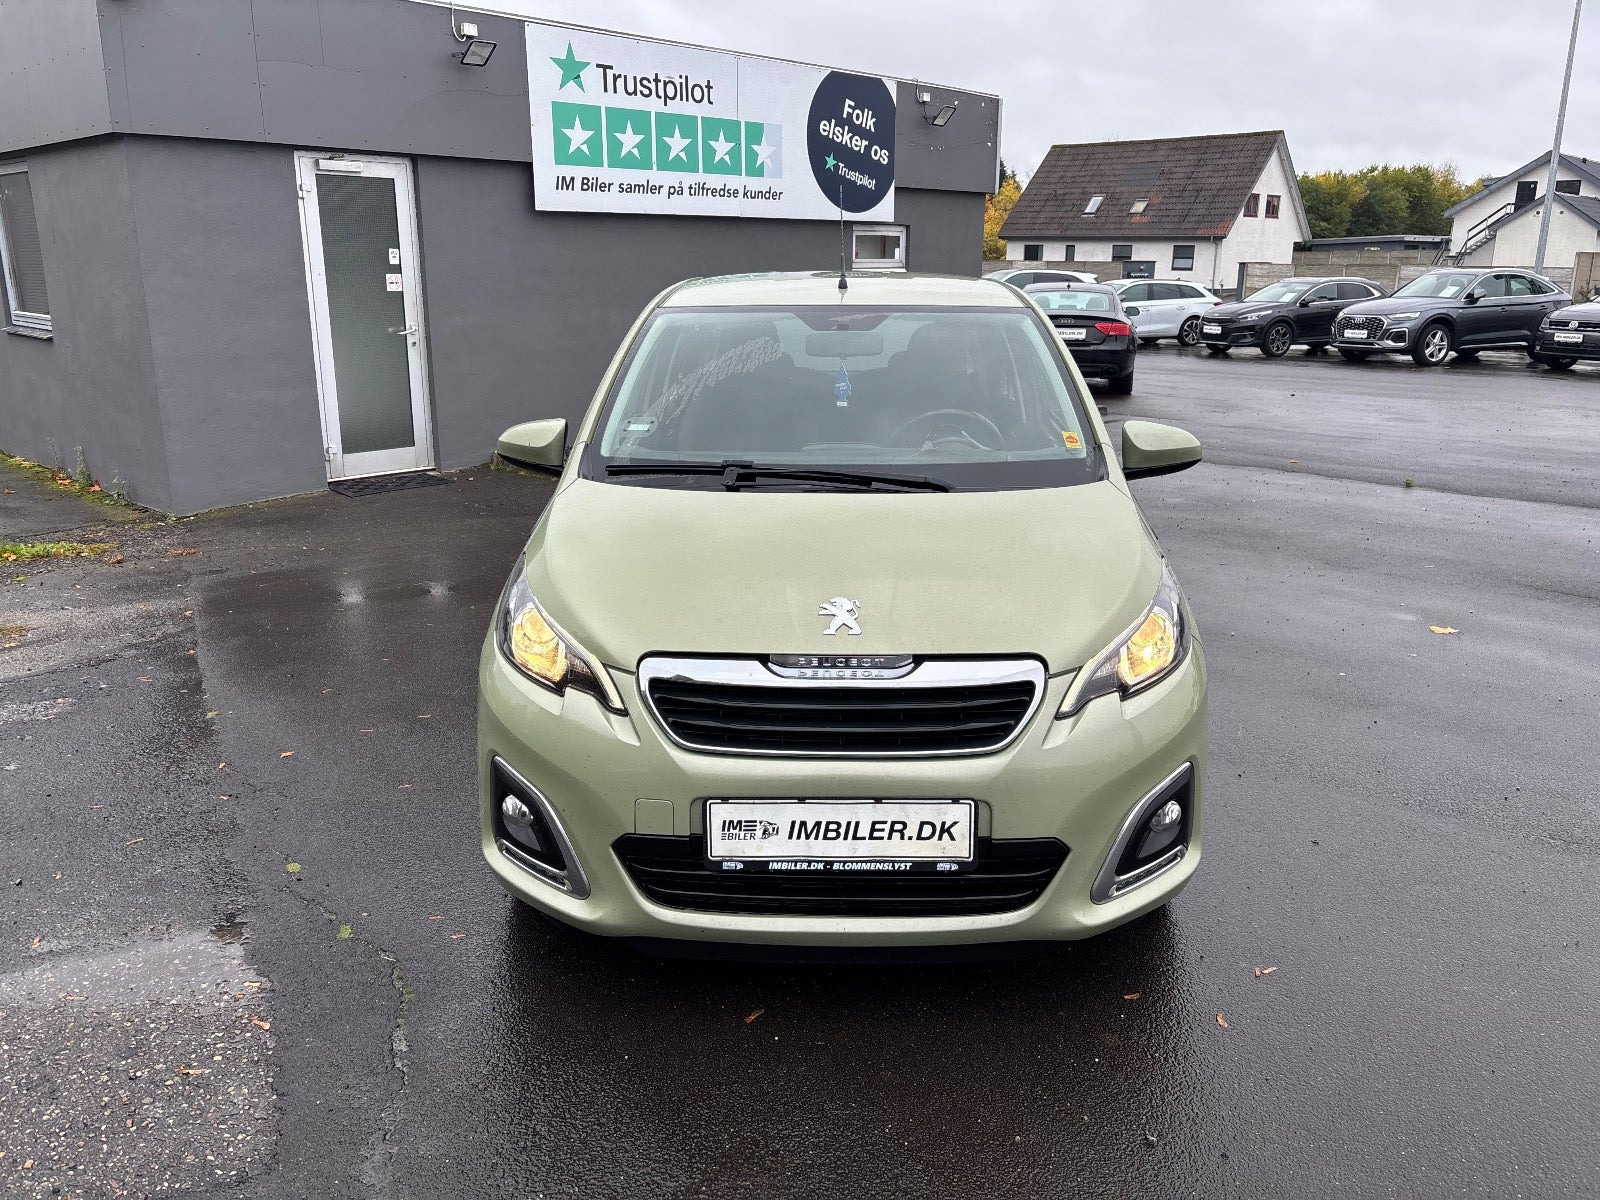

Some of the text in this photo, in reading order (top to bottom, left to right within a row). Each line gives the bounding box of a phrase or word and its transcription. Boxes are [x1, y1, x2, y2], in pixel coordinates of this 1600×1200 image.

[596, 63, 714, 106] Trustpilot
[842, 98, 877, 133] Folk
[819, 118, 889, 165] elsker os
[555, 175, 783, 201] IM Biler samler på tilfredse kunder
[838, 162, 876, 190] Trustpilot
[797, 657, 885, 667] PEUGEOT
[787, 819, 961, 842] IMBILER.DK
[768, 861, 826, 871] IMBILER.DK
[832, 862, 913, 871] BLOMMENSLYST
